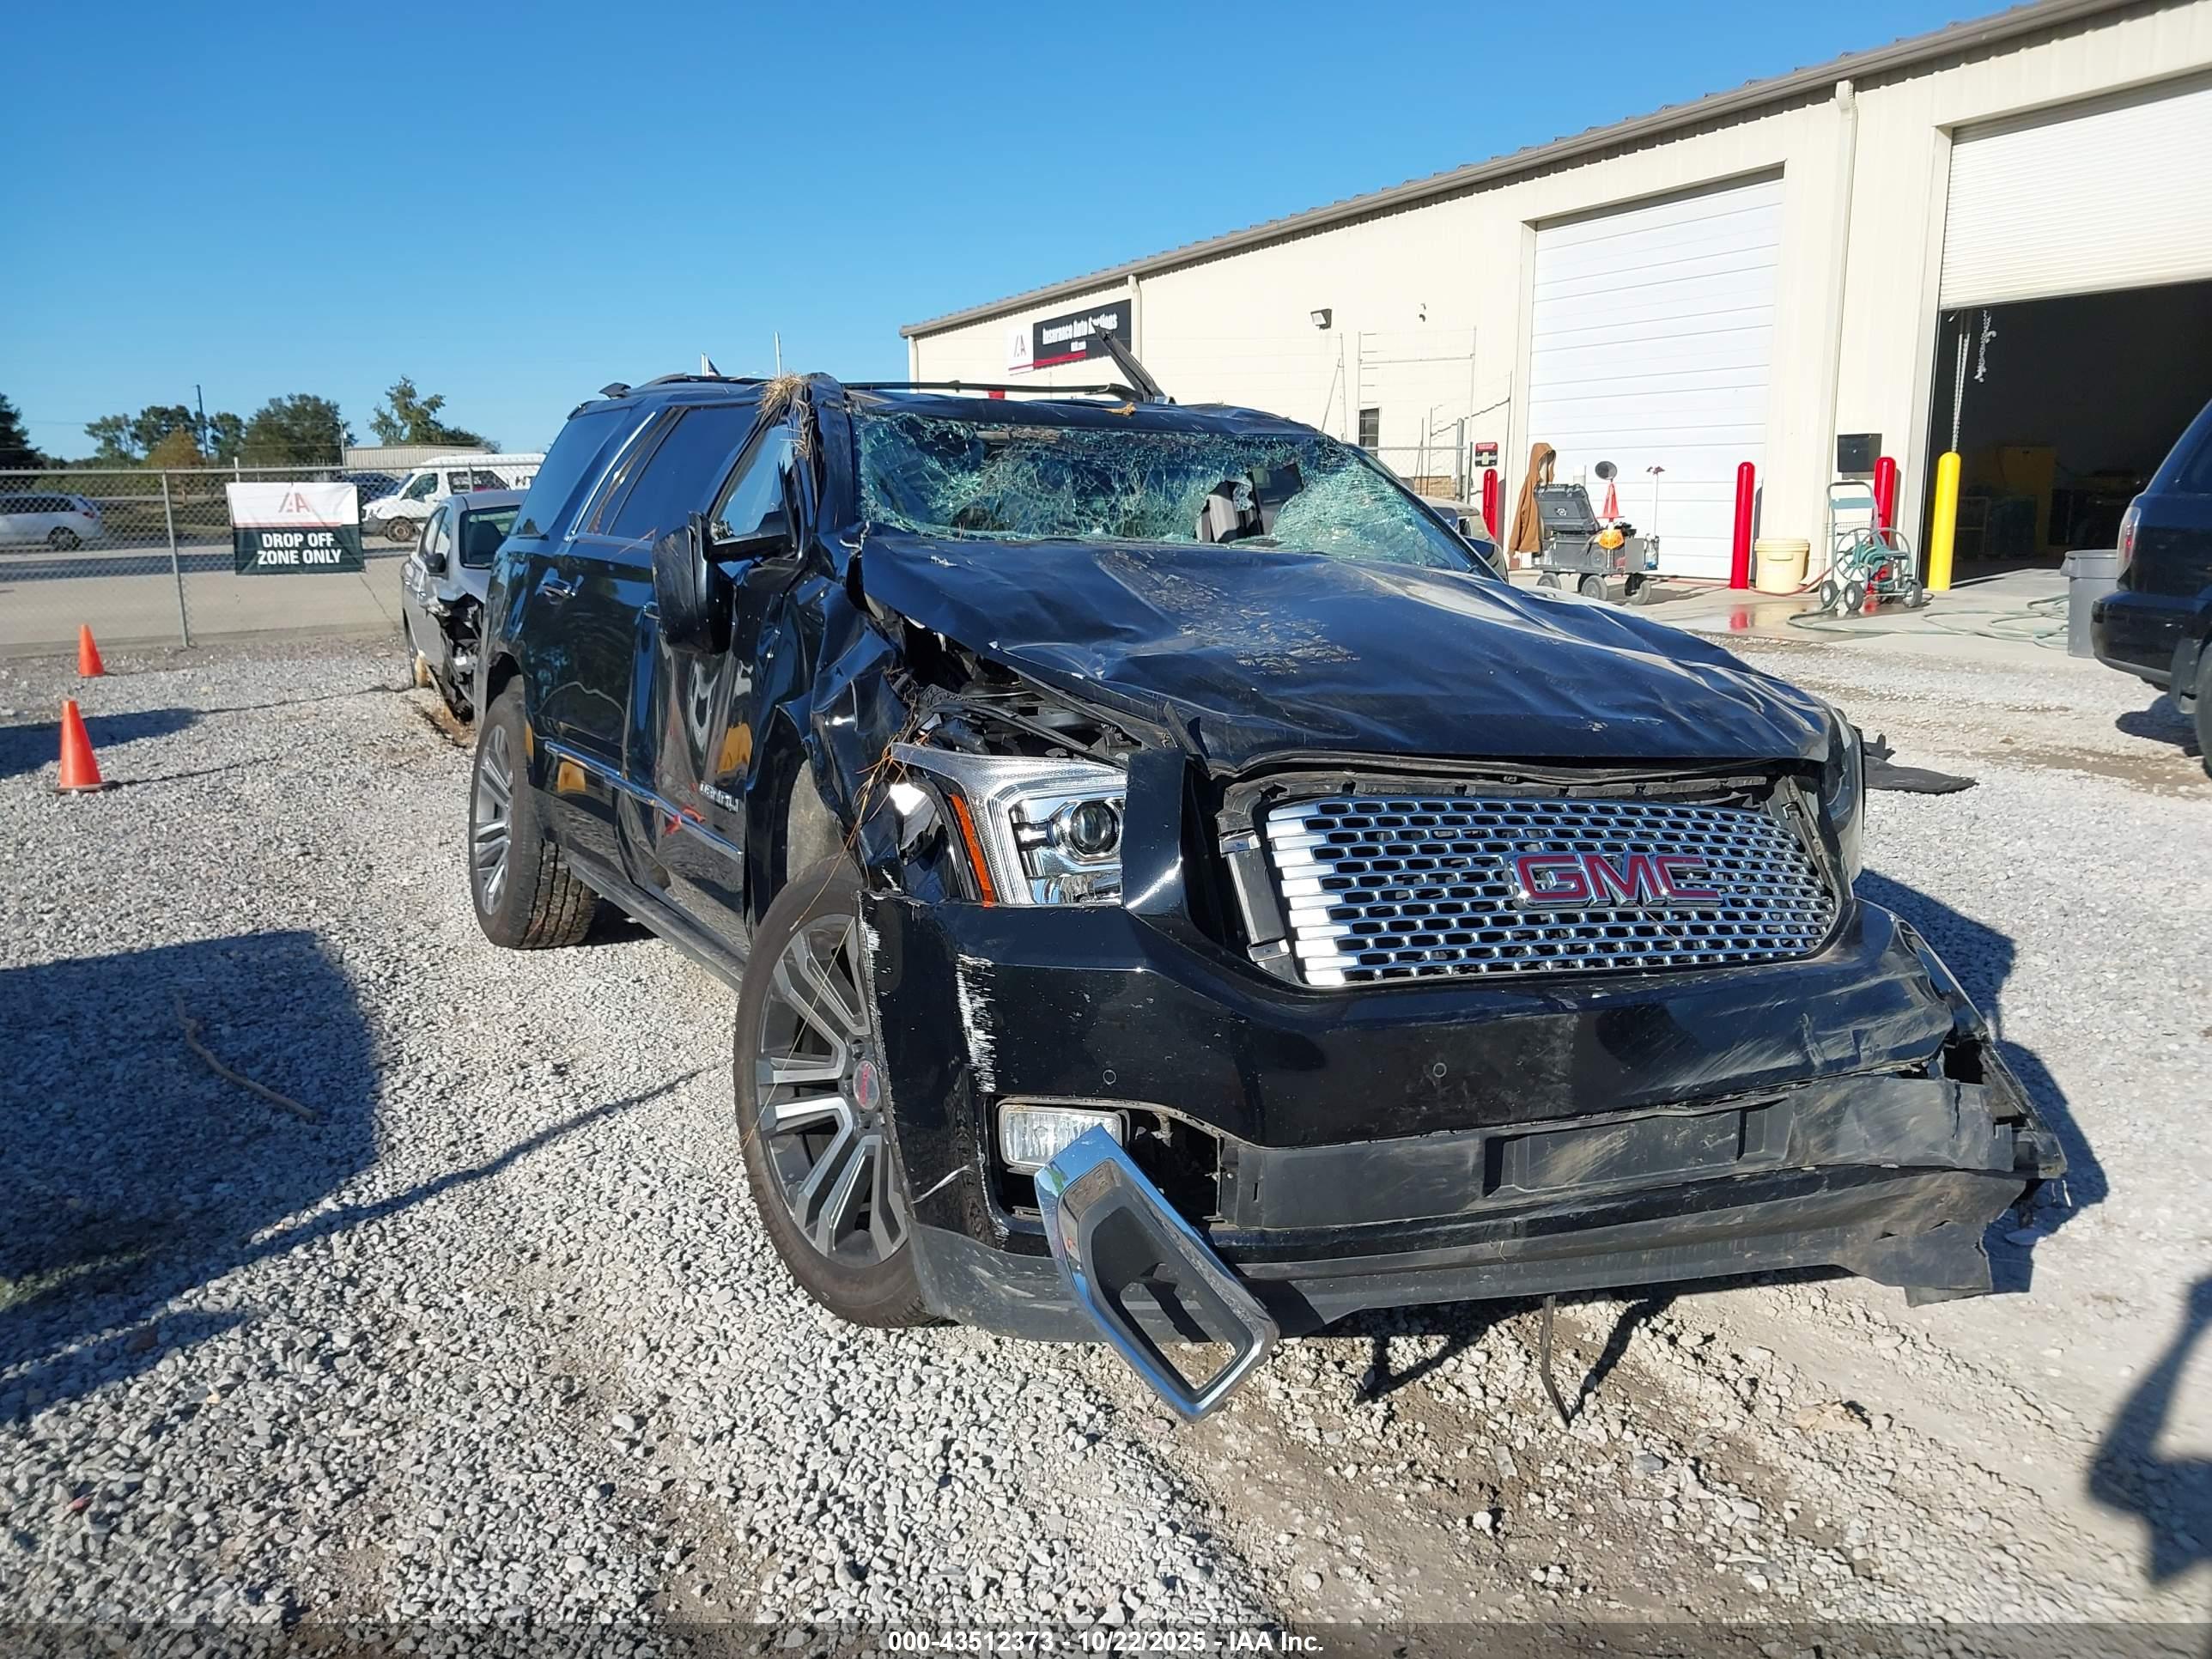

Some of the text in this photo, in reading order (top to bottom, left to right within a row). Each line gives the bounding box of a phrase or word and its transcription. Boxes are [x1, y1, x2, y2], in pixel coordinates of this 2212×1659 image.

[261, 532, 335, 548] DROP OFF
[258, 549, 343, 565] ZONE ONLY
[1515, 854, 1722, 908] GMC
